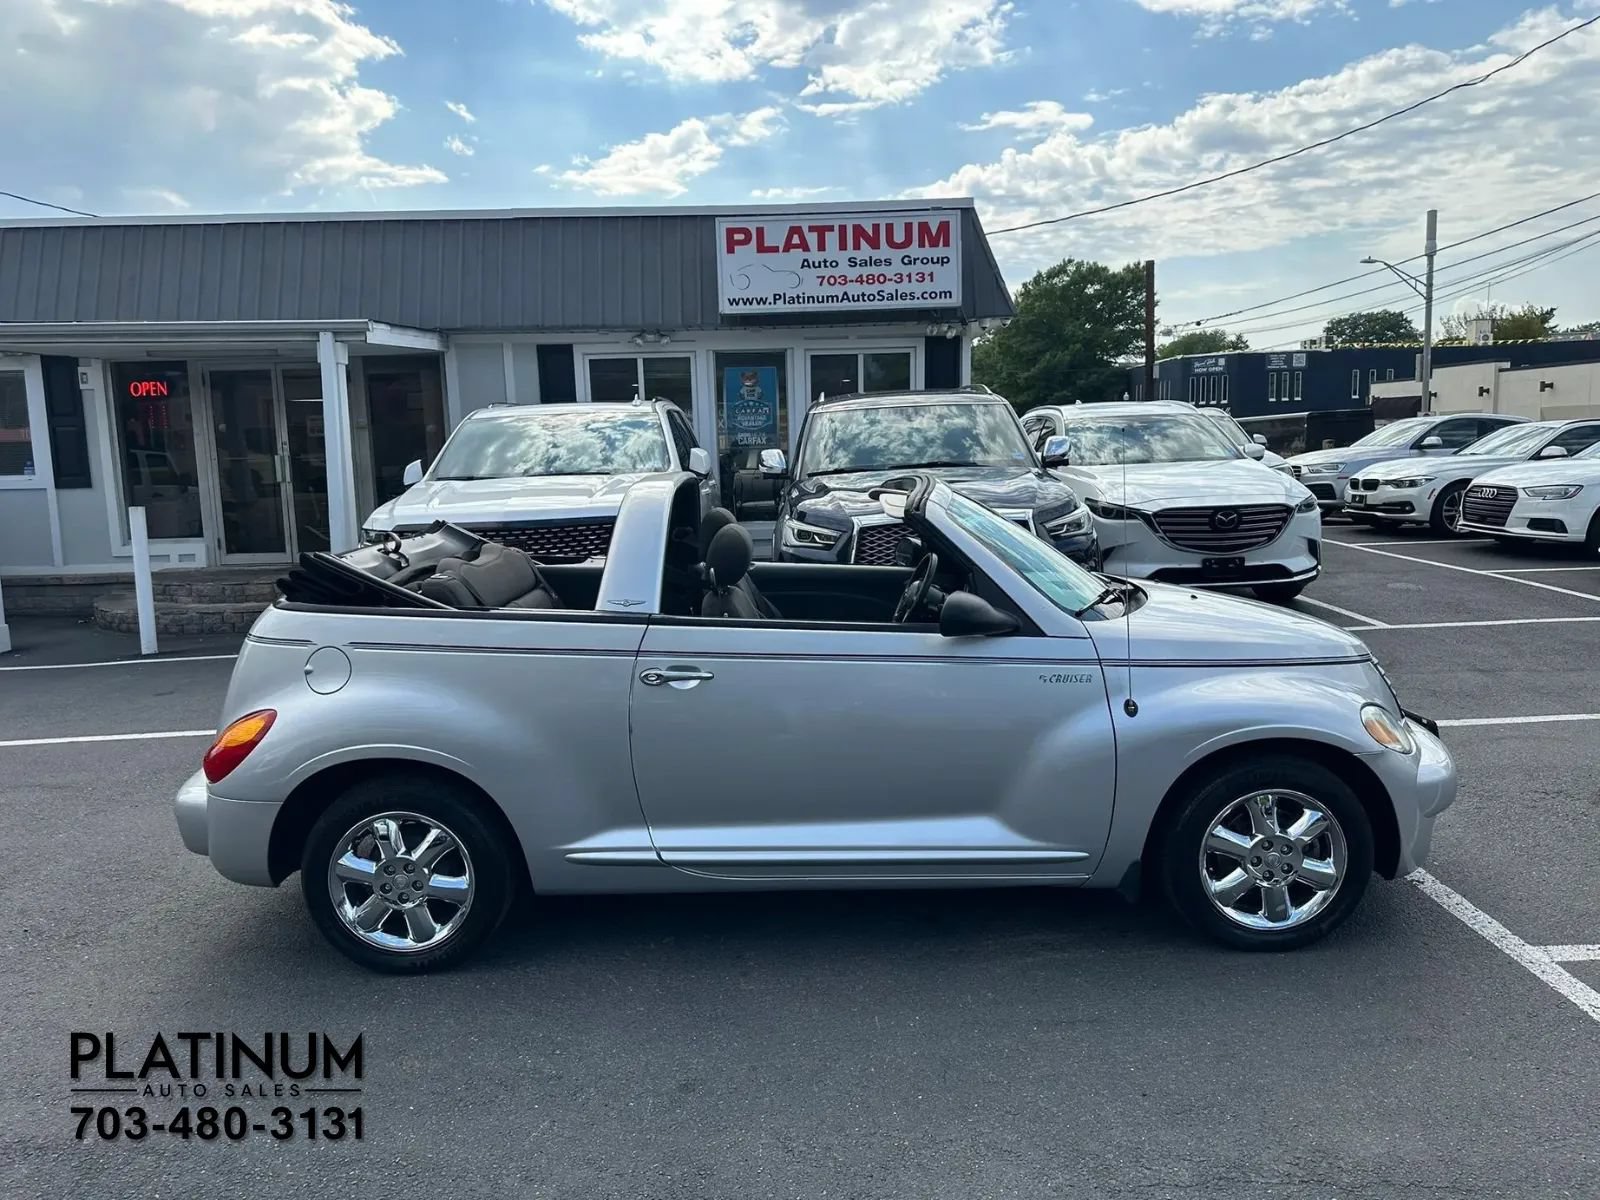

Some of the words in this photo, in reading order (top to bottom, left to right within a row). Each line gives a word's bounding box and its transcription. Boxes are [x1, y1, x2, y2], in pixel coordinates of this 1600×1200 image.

[725, 220, 951, 254] PLATINUM
[800, 258, 839, 269] Auto
[847, 256, 892, 268] Sales
[901, 254, 951, 267] Group
[816, 271, 935, 287] 703-480-3131
[727, 288, 953, 306] www.PlatinumAutoSales.com
[129, 381, 168, 397] OPEN
[738, 437, 766, 445] CARFAX
[1049, 673, 1093, 684] CRUISER
